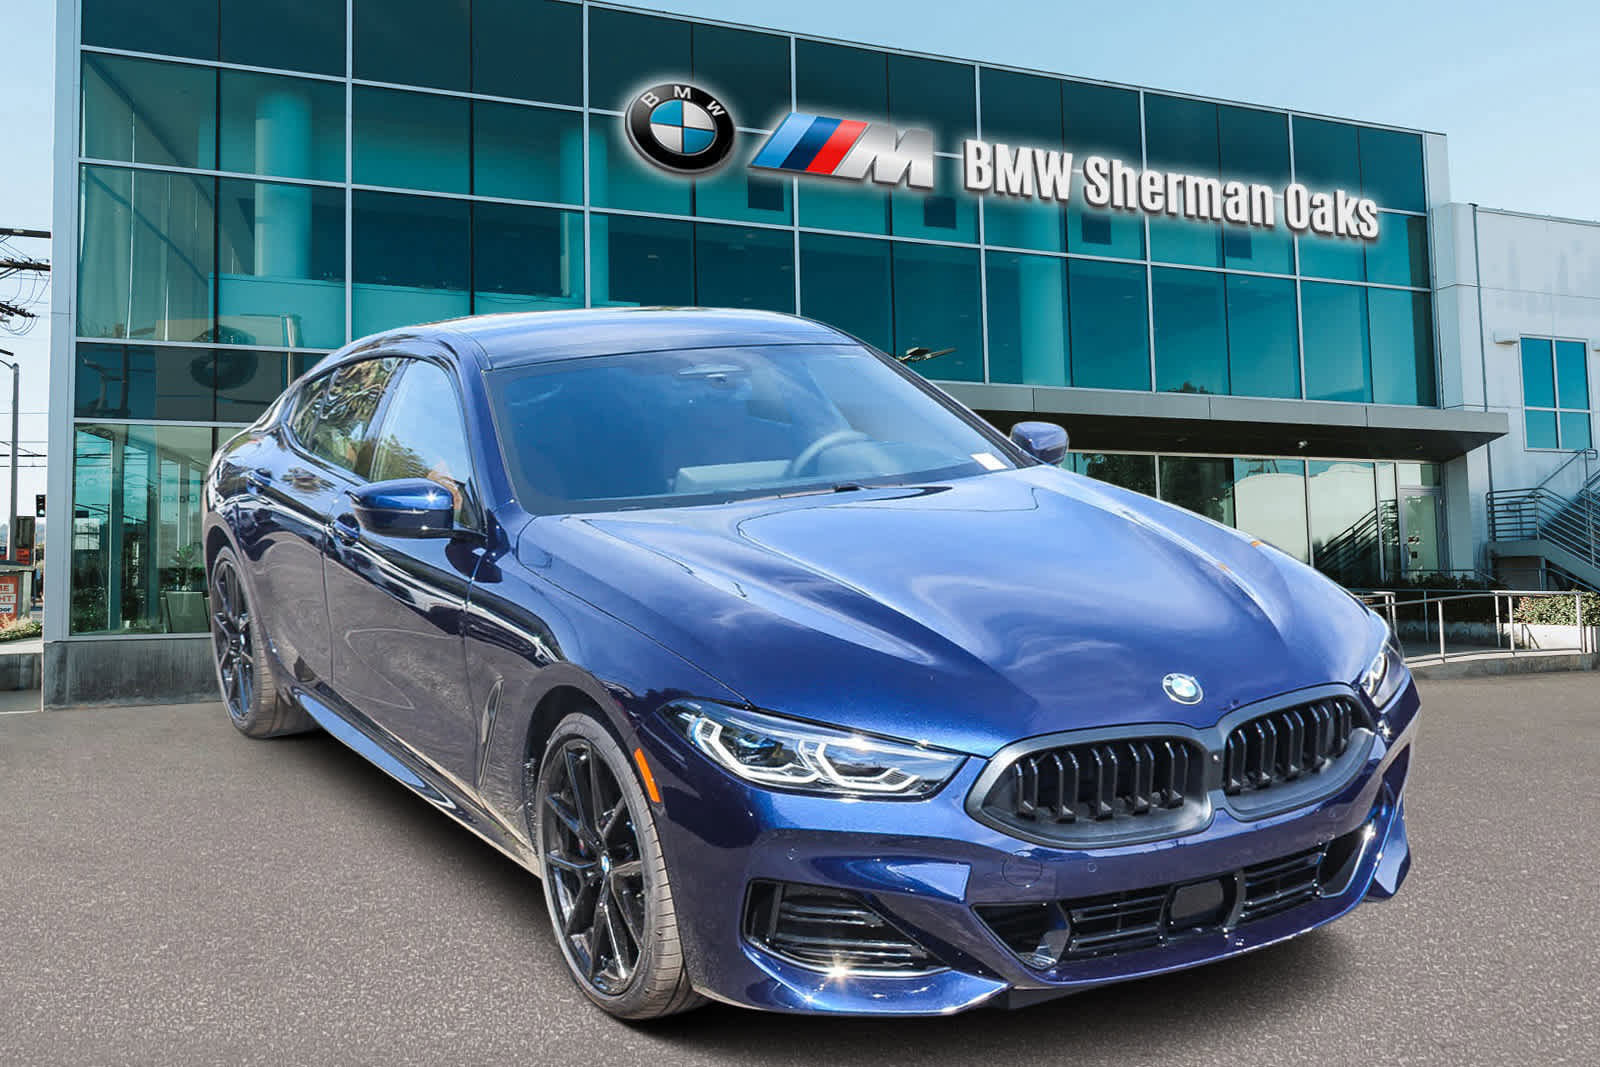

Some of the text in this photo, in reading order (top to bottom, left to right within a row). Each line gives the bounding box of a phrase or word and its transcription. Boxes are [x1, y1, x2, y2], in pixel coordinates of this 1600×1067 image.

[640, 85, 726, 117] BMW
[832, 121, 935, 189] M
[963, 138, 1379, 240] BMW Sherman Oaks
